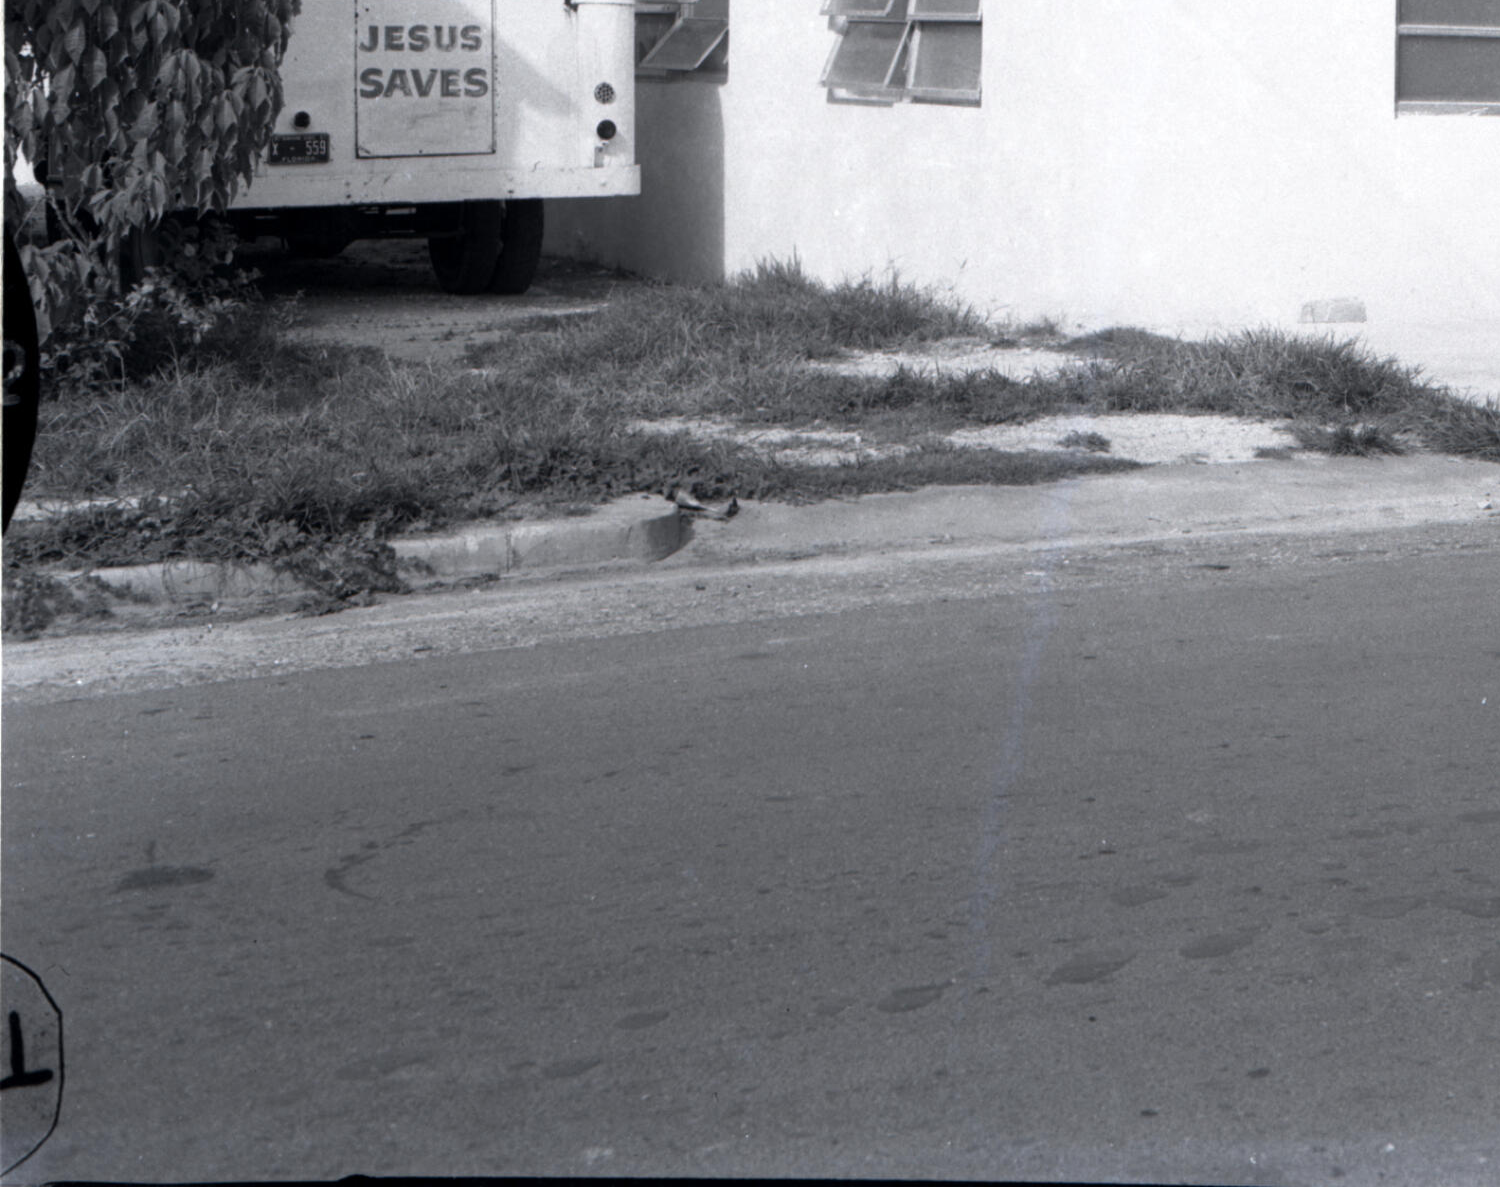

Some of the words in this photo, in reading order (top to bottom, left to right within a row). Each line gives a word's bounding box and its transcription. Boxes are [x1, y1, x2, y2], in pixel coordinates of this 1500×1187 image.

[359, 24, 483, 53] JESUS
[359, 67, 489, 99] SAVES
[305, 140, 326, 156] 559
